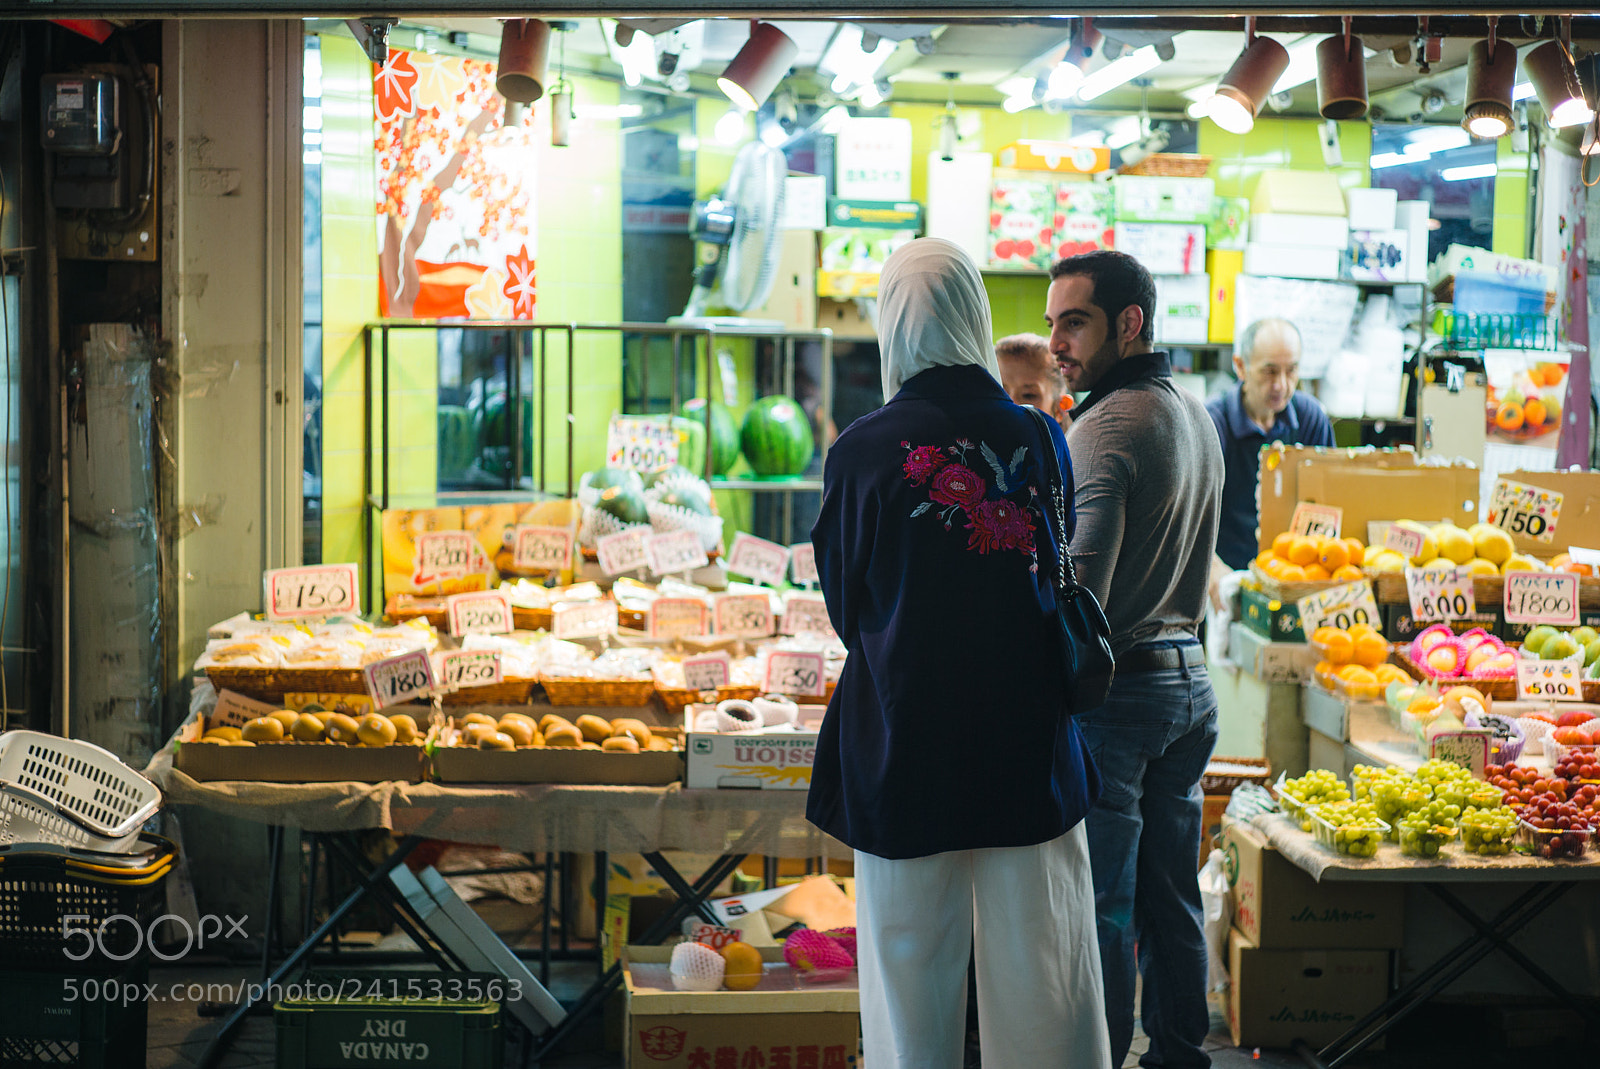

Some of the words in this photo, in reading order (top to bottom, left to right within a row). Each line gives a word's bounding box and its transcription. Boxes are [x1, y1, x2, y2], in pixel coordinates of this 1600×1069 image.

[1500, 507, 1546, 535] 150
[296, 584, 347, 608] 150
[1422, 595, 1467, 617] 600
[456, 664, 494, 682] 150
[390, 670, 427, 696] 180
[1533, 682, 1568, 694] 500
[734, 739, 788, 747] AVOCADOS
[361, 1019, 407, 1037] DRY
[339, 1042, 430, 1060] CANADA
